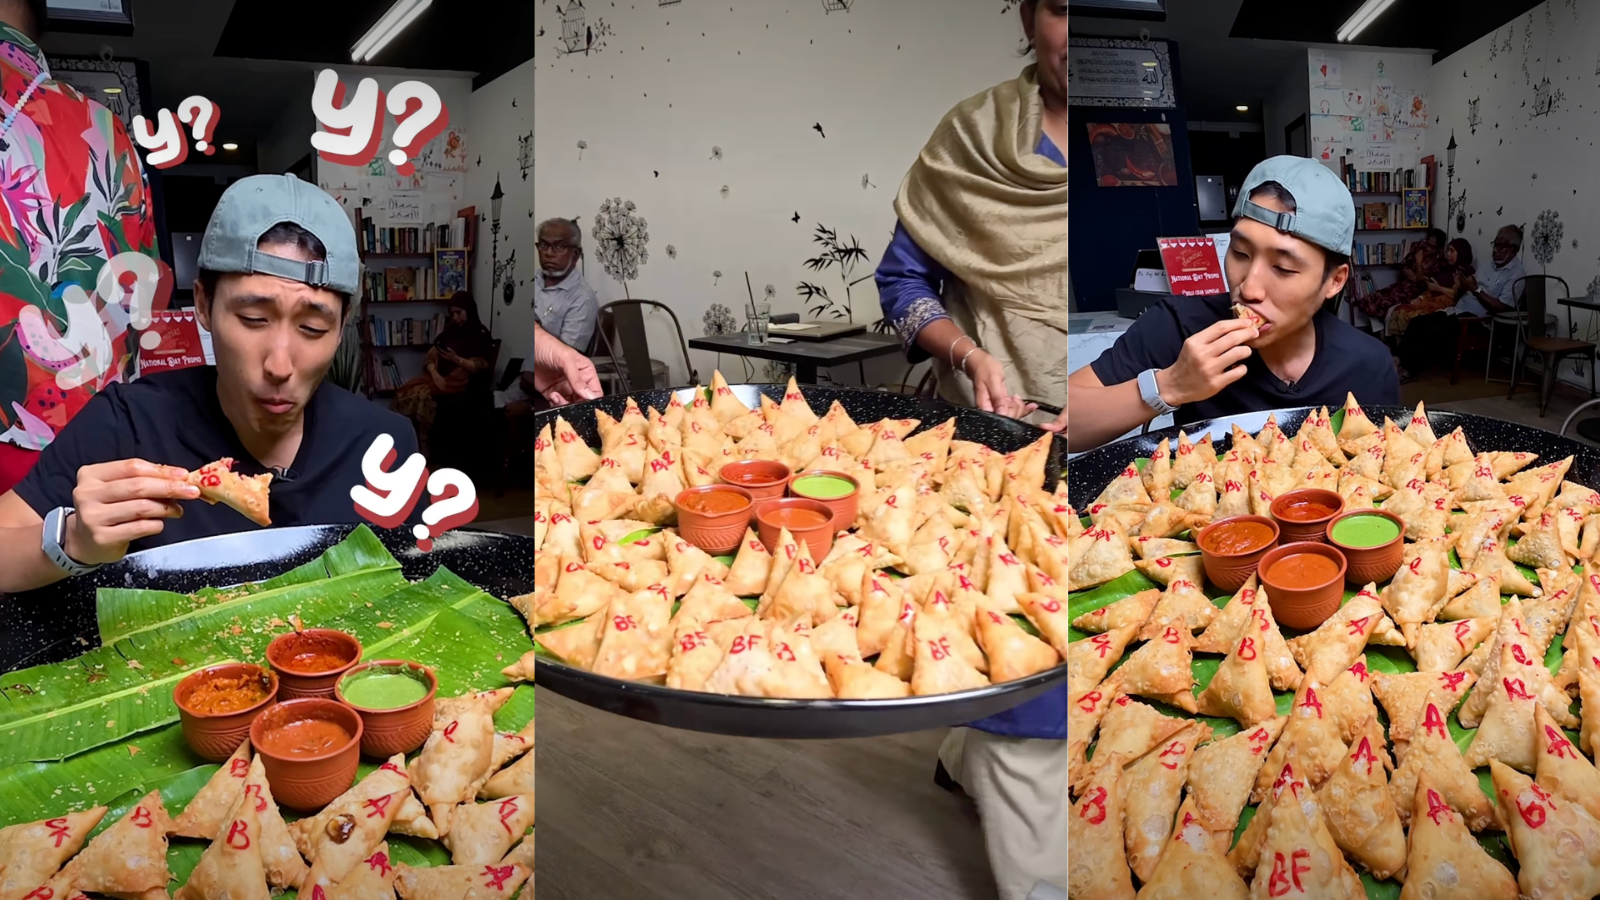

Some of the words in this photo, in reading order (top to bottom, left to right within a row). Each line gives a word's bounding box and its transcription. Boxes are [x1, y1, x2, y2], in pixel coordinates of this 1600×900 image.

[1171, 274, 1192, 283] NATIONAL
[1192, 273, 1203, 281] DAY
[1204, 272, 1219, 280] PROMO
[140, 358, 167, 369] NATIONAL
[167, 356, 181, 367] DAY
[182, 355, 202, 365] PROMO
[799, 558, 814, 574] B
[1241, 588, 1256, 605] B
[1162, 626, 1180, 644] B
[1346, 616, 1369, 636] A
[729, 634, 763, 655] BF
[1237, 636, 1257, 661] B
[1299, 687, 1323, 720] A
[1421, 703, 1446, 739] A
[1545, 724, 1577, 760] A
[1350, 736, 1378, 775] A
[230, 758, 249, 777] B
[130, 806, 153, 828] B
[363, 794, 391, 819] A
[1427, 788, 1453, 826] A
[226, 819, 250, 850] B
[1268, 848, 1311, 897] BF
